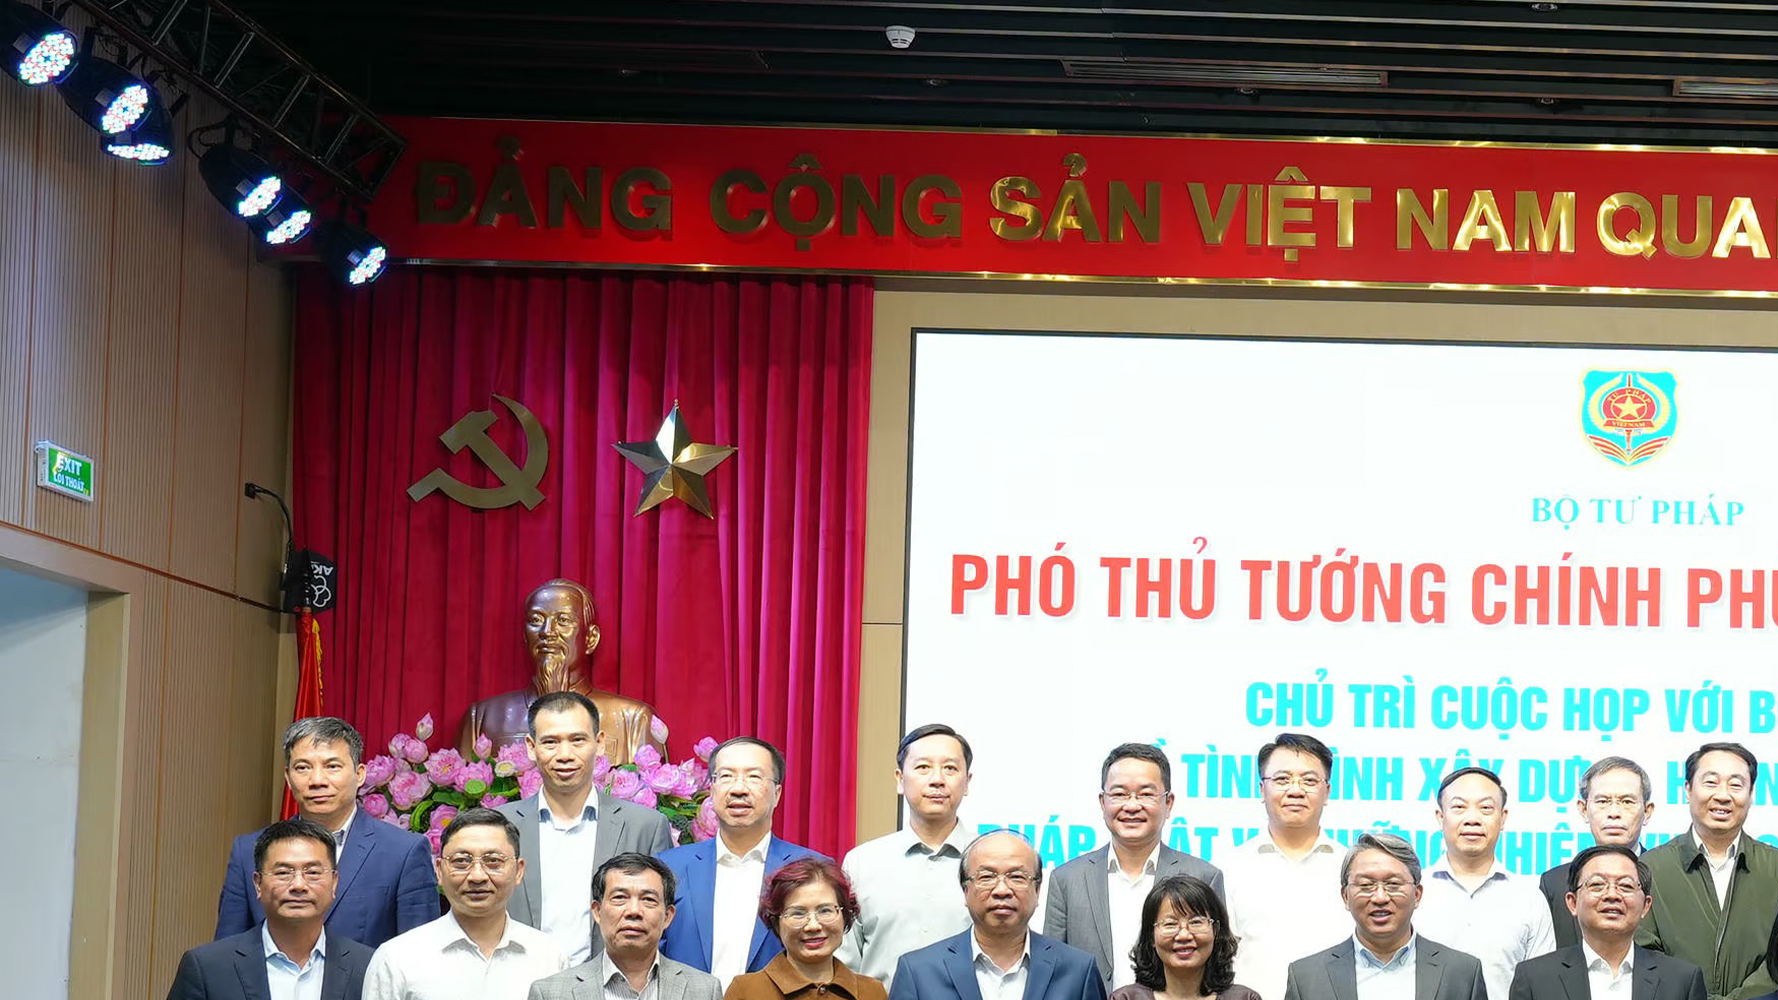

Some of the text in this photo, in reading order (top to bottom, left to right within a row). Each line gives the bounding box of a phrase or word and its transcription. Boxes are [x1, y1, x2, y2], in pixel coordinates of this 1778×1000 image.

[414, 136, 674, 232] ĐẢNG
[709, 152, 963, 251] CỘNG
[989, 152, 1162, 244] SẢN
[1187, 166, 1372, 263] VIỆT
[1395, 187, 1577, 254] NAM
[57, 453, 82, 476] EXIT
[1532, 492, 1745, 531] BỘ TƯ PHÁP
[951, 542, 1075, 617] PHÓ
[1100, 537, 1216, 620] THỦ
[1241, 548, 1445, 625] TƯỚNG
[1472, 552, 1661, 627] CHÍNH
[1246, 667, 1334, 728] CHỦ
[1348, 675, 1416, 729] TRÌ
[1431, 676, 1548, 740] CUỘC
[1563, 687, 1650, 742] HỌP
[1664, 679, 1734, 734] VỚI
[1181, 744, 1262, 799] TÌN
[1329, 746, 1404, 801] ÌNH
